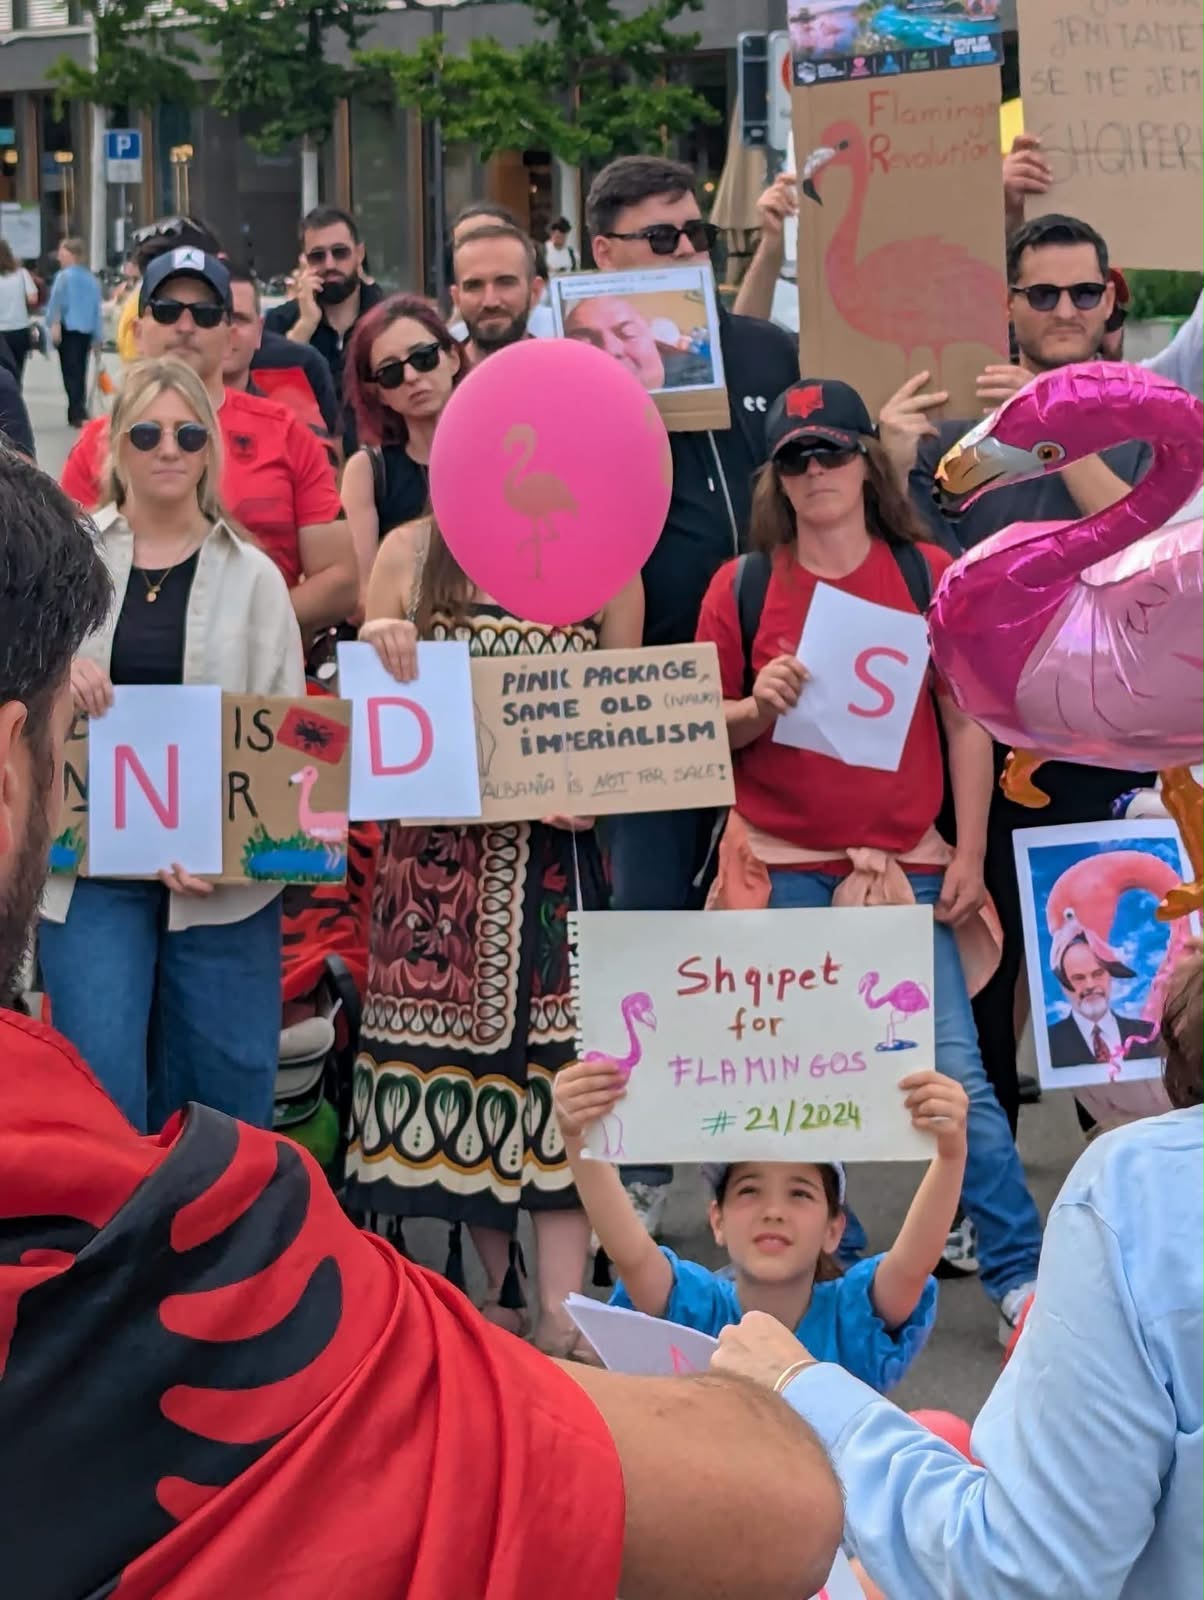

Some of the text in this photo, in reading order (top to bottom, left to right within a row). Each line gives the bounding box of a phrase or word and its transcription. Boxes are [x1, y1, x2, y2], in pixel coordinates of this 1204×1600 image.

[1031, 65, 1068, 96] SE
[116, 135, 132, 157] P
[848, 647, 909, 719] S
[503, 698, 580, 726] SAME
[601, 694, 652, 716] OLD
[234, 705, 275, 752] IS
[367, 697, 434, 776] D
[114, 744, 180, 830] N
[592, 769, 634, 798] NOT
[637, 766, 666, 786] FOR
[677, 950, 843, 1008] Shqipet
[727, 1006, 785, 1041] for
[667, 1051, 867, 1087] FLAMINGOS
